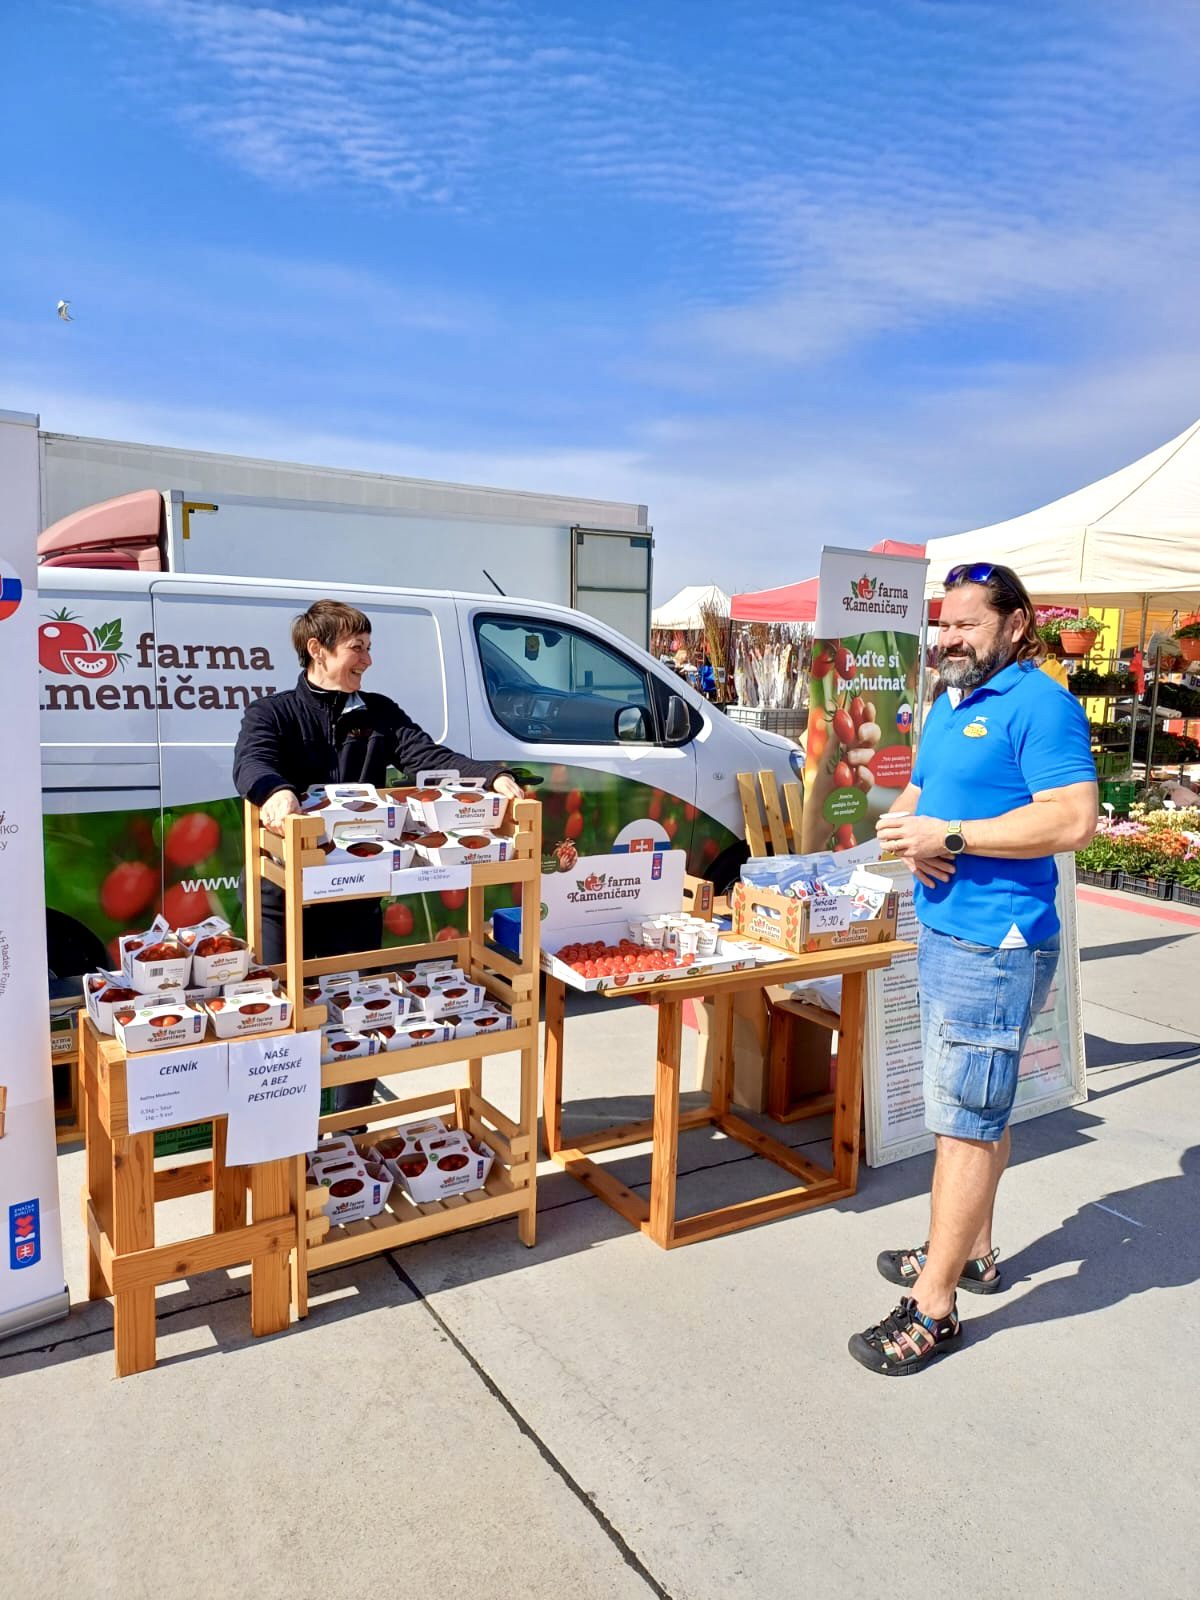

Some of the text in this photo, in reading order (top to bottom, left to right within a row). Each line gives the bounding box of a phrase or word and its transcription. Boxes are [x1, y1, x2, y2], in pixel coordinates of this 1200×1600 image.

[878, 583, 908, 599] farma
[843, 597, 908, 618] Kameničany
[136, 632, 274, 670] farma
[846, 650, 899, 671] poďte si
[837, 674, 906, 693] pochutnať
[39, 674, 276, 711] meničan
[181, 876, 240, 893] www
[330, 874, 366, 886] CENNÍK
[607, 875, 641, 888] farma
[567, 887, 641, 904] Kameničany
[264, 1048, 290, 1060] NAŠE
[159, 1061, 199, 1076] CENNÍK
[248, 1058, 302, 1077] SLOVENSKÉ
[261, 1076, 288, 1087] A BEZ
[248, 1084, 307, 1103] PESTICÍDOV!
